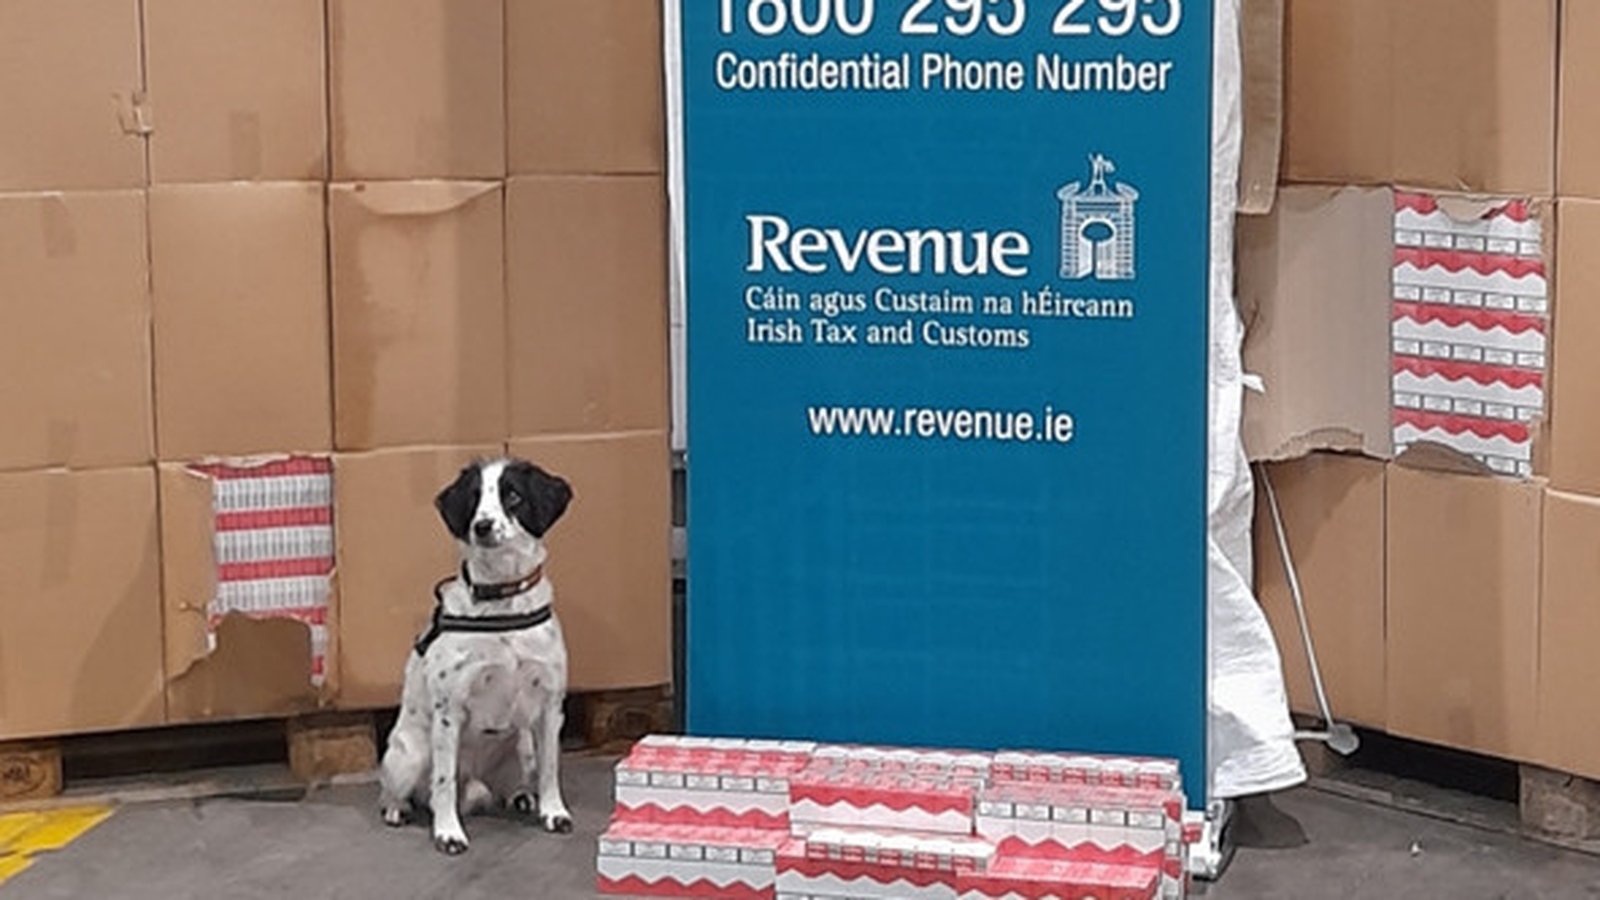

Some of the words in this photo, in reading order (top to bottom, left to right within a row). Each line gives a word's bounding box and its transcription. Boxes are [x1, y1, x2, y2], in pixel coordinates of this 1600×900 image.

[716, 51, 910, 90] Confidential
[922, 52, 1025, 91] Phone
[1036, 53, 1173, 92] Number
[745, 214, 1030, 277] Revenue
[745, 286, 801, 311] Cáin
[809, 291, 867, 317] agus
[874, 287, 974, 314] Custaim
[983, 296, 1013, 315] na
[1022, 285, 1133, 318] hÉireann
[748, 317, 803, 343] Irish
[810, 318, 857, 344] Tax
[866, 319, 913, 345] and
[922, 320, 1030, 348] Customs
[808, 406, 1075, 443] www.revenue.ie
